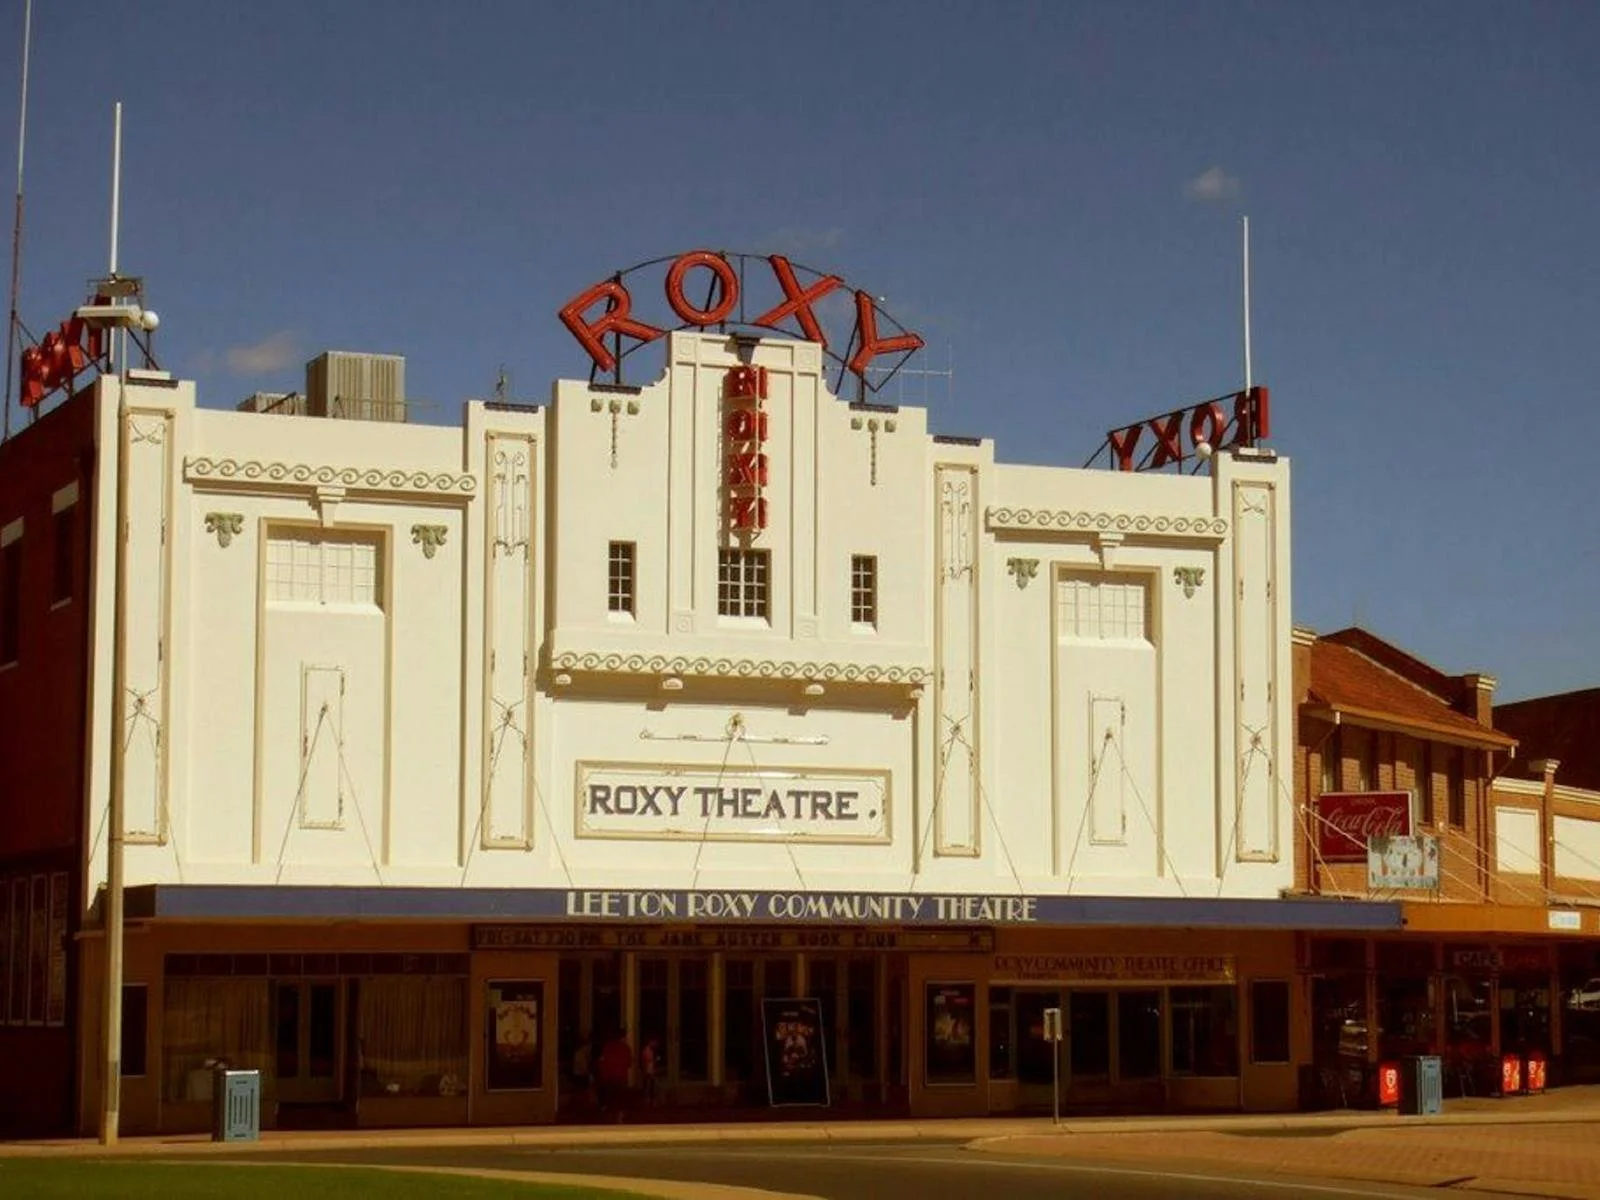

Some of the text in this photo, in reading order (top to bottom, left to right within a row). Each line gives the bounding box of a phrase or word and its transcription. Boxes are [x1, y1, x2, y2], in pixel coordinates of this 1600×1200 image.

[558, 250, 925, 376] ROXY
[588, 784, 859, 820] ROXY THEATRE
[566, 891, 1038, 921] LEETON ROXY COMMUNITY THEATRE
